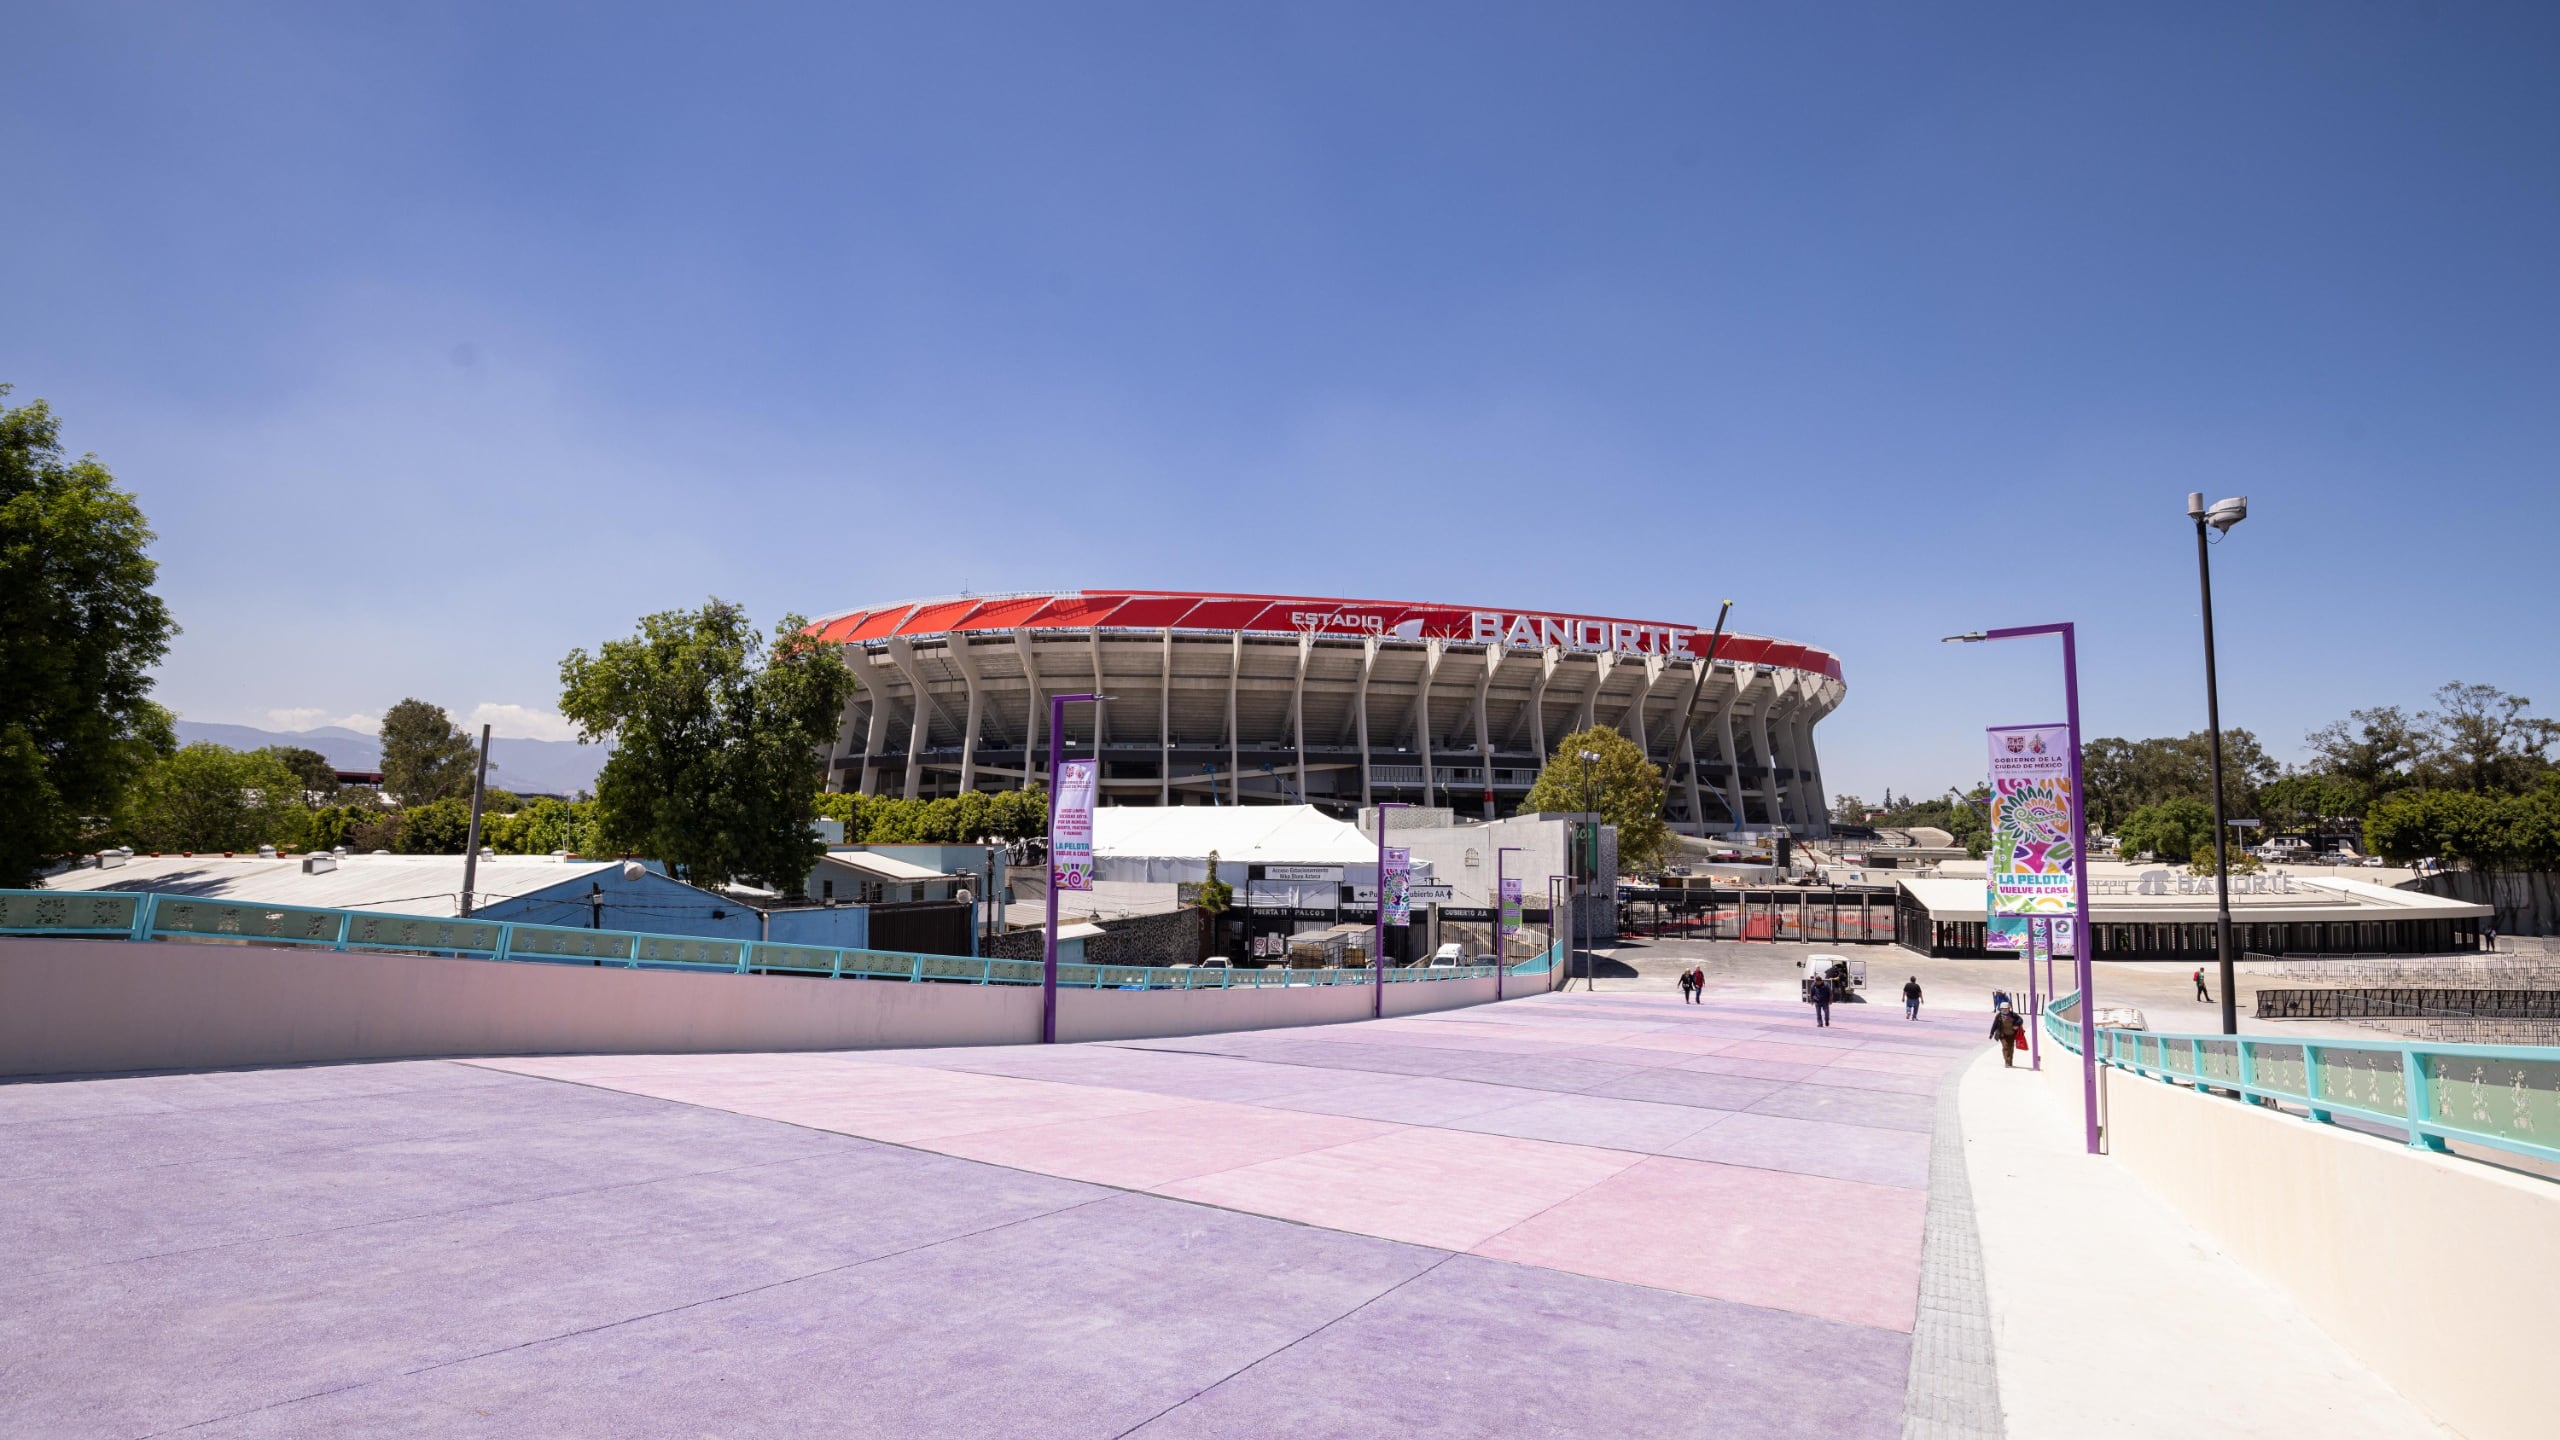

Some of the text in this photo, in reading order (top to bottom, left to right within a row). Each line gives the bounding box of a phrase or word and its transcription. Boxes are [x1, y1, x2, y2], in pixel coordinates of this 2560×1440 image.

[1292, 612, 1383, 628] ESTADIO
[1472, 612, 1696, 658] BANORTE
[1056, 842, 1090, 850] LA PELOTA
[1998, 874, 2068, 885] LA PELOTA
[1409, 890, 1445, 898] ubierto AA
[2000, 886, 2069, 894] VUELVE A CASA
[1253, 908, 1279, 916] PUERTA
[1294, 909, 1326, 917] PALCOS
